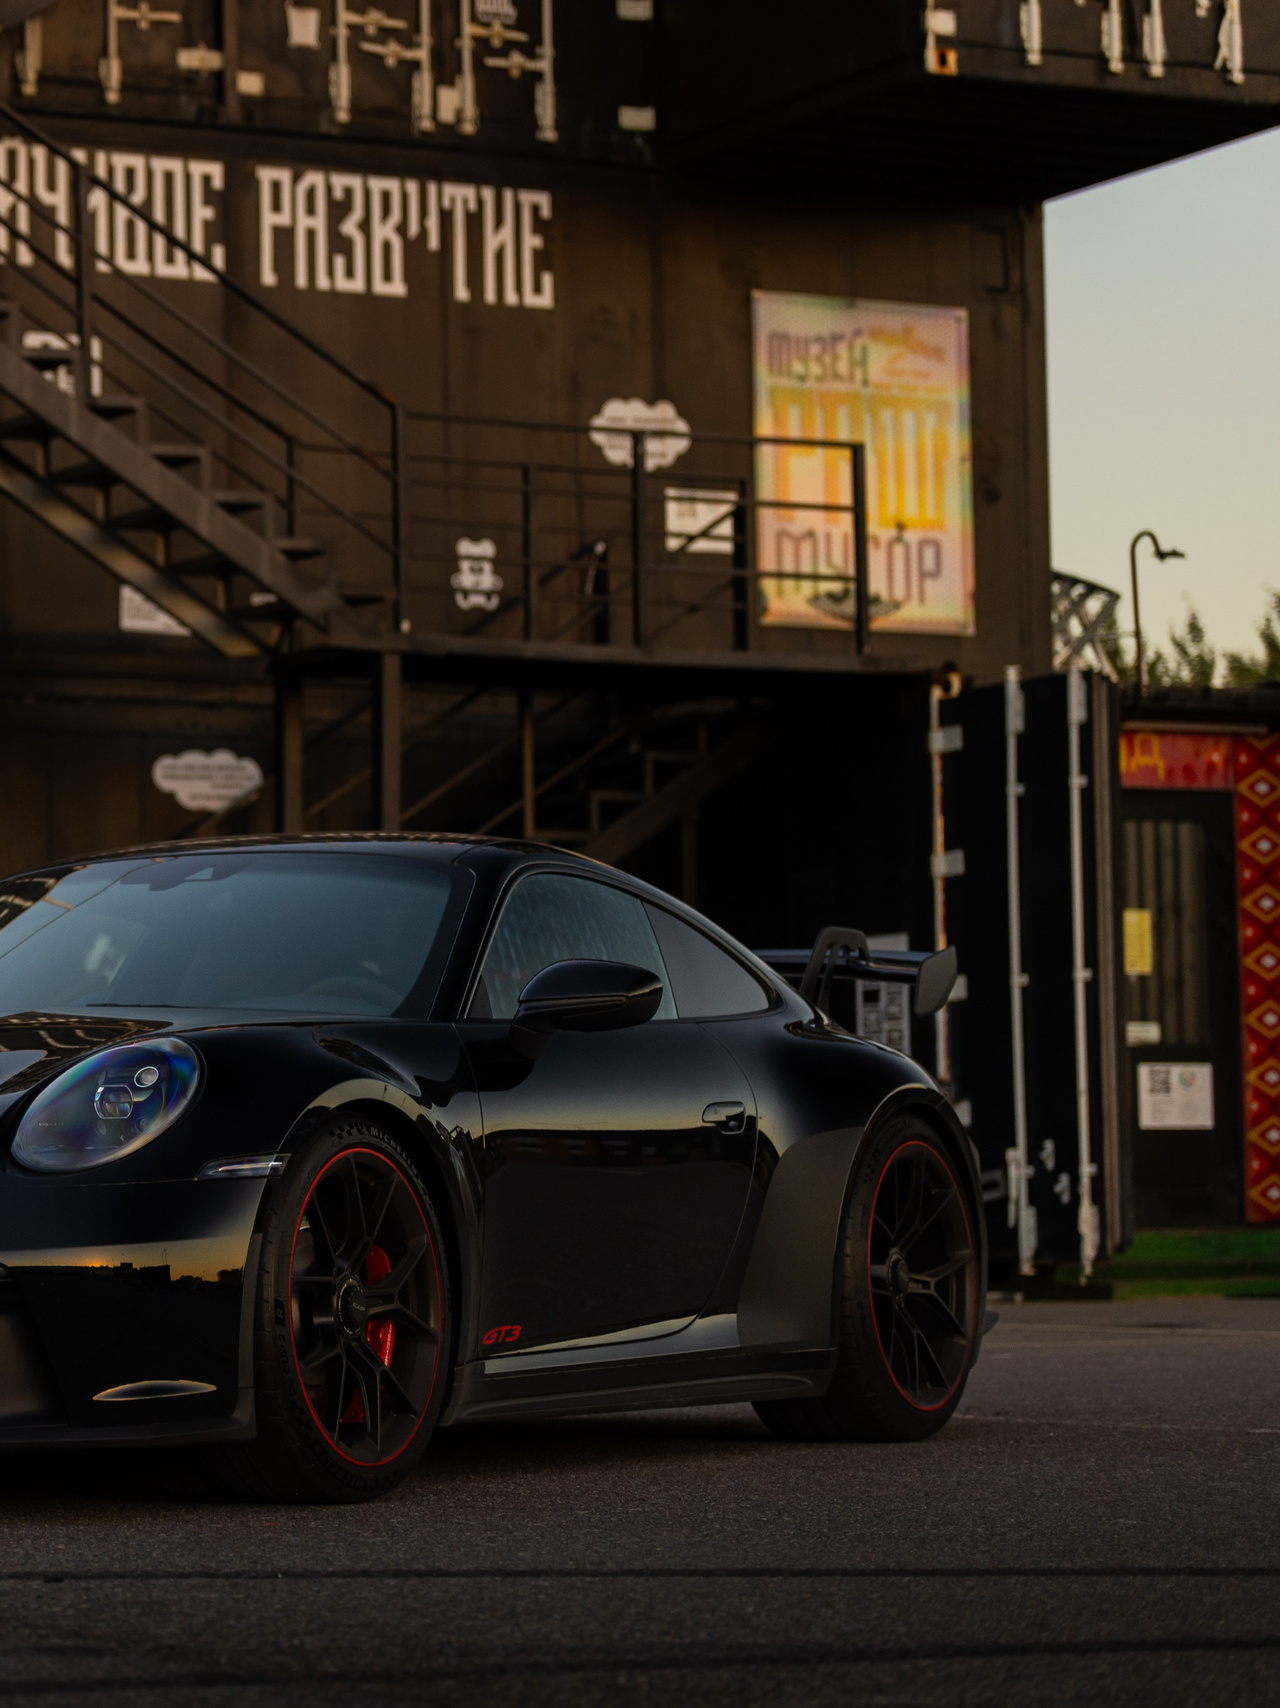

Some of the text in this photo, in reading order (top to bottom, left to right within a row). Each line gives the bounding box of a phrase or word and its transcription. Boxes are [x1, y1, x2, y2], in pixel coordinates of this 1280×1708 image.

[776, 528, 942, 606] МУОР
[369, 1126, 419, 1178] MICHELIN
[277, 1332, 286, 1343] 2
[482, 1324, 522, 1345] GT3
[278, 1343, 291, 1375] CUP
